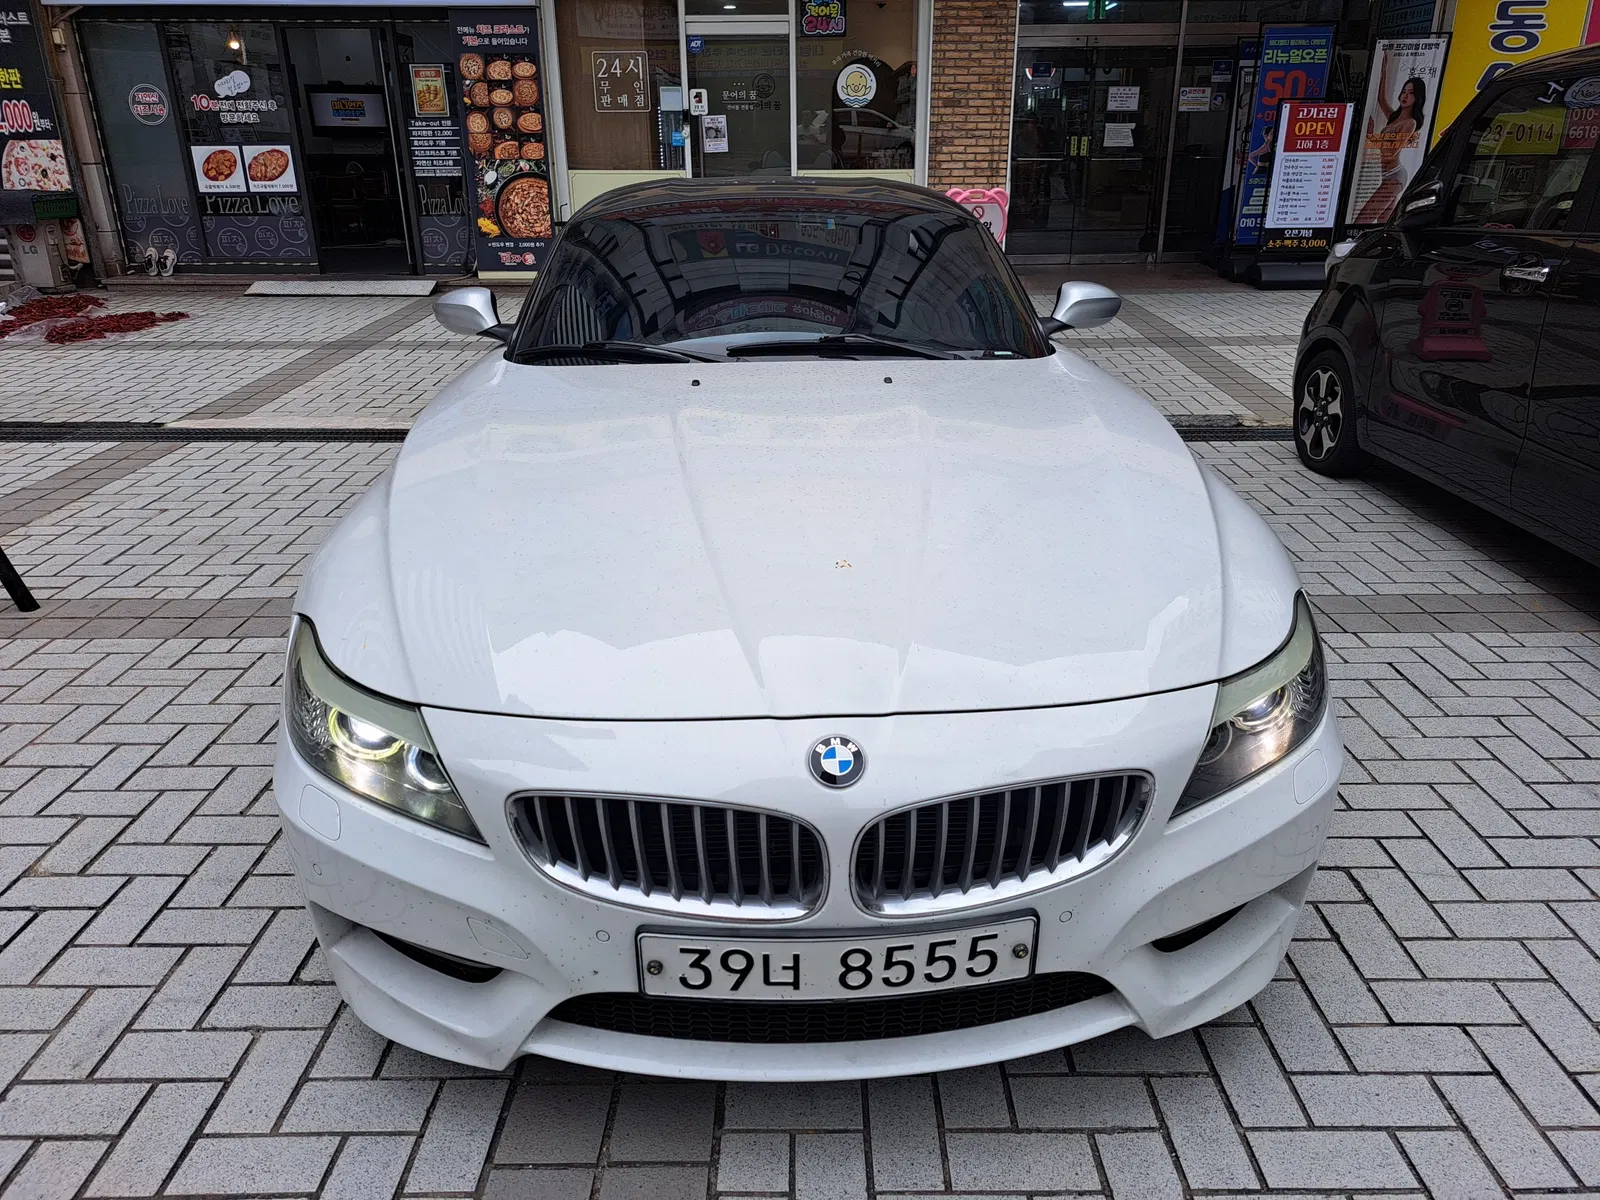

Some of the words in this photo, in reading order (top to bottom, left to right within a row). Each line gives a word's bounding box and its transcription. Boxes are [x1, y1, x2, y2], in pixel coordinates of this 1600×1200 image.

[804, 16, 844, 32] 24시
[689, 40, 701, 48] ADT
[1264, 49, 1327, 64] 리뉴얼오픈
[596, 56, 643, 80] 24시
[1261, 69, 1320, 106] 50%
[600, 94, 645, 108] 판매점
[721, 90, 746, 100] 문어의
[220, 111, 260, 124] 방문하세요
[1296, 107, 1339, 119] 고기고집
[1294, 121, 1336, 136] OPEN
[1295, 140, 1314, 150] 지하
[121, 182, 158, 215] Pizza
[156, 184, 189, 215] Love
[205, 195, 256, 215] Pizza
[256, 195, 301, 215] Love
[418, 184, 449, 215] Pizza
[1240, 218, 1256, 228] 010
[1283, 229, 1313, 238] 오픈기념
[21, 245, 39, 255] LG
[1300, 239, 1327, 248] 3,000
[814, 737, 859, 754] BMW
[677, 947, 801, 993] 39너
[837, 932, 999, 993] 8555
